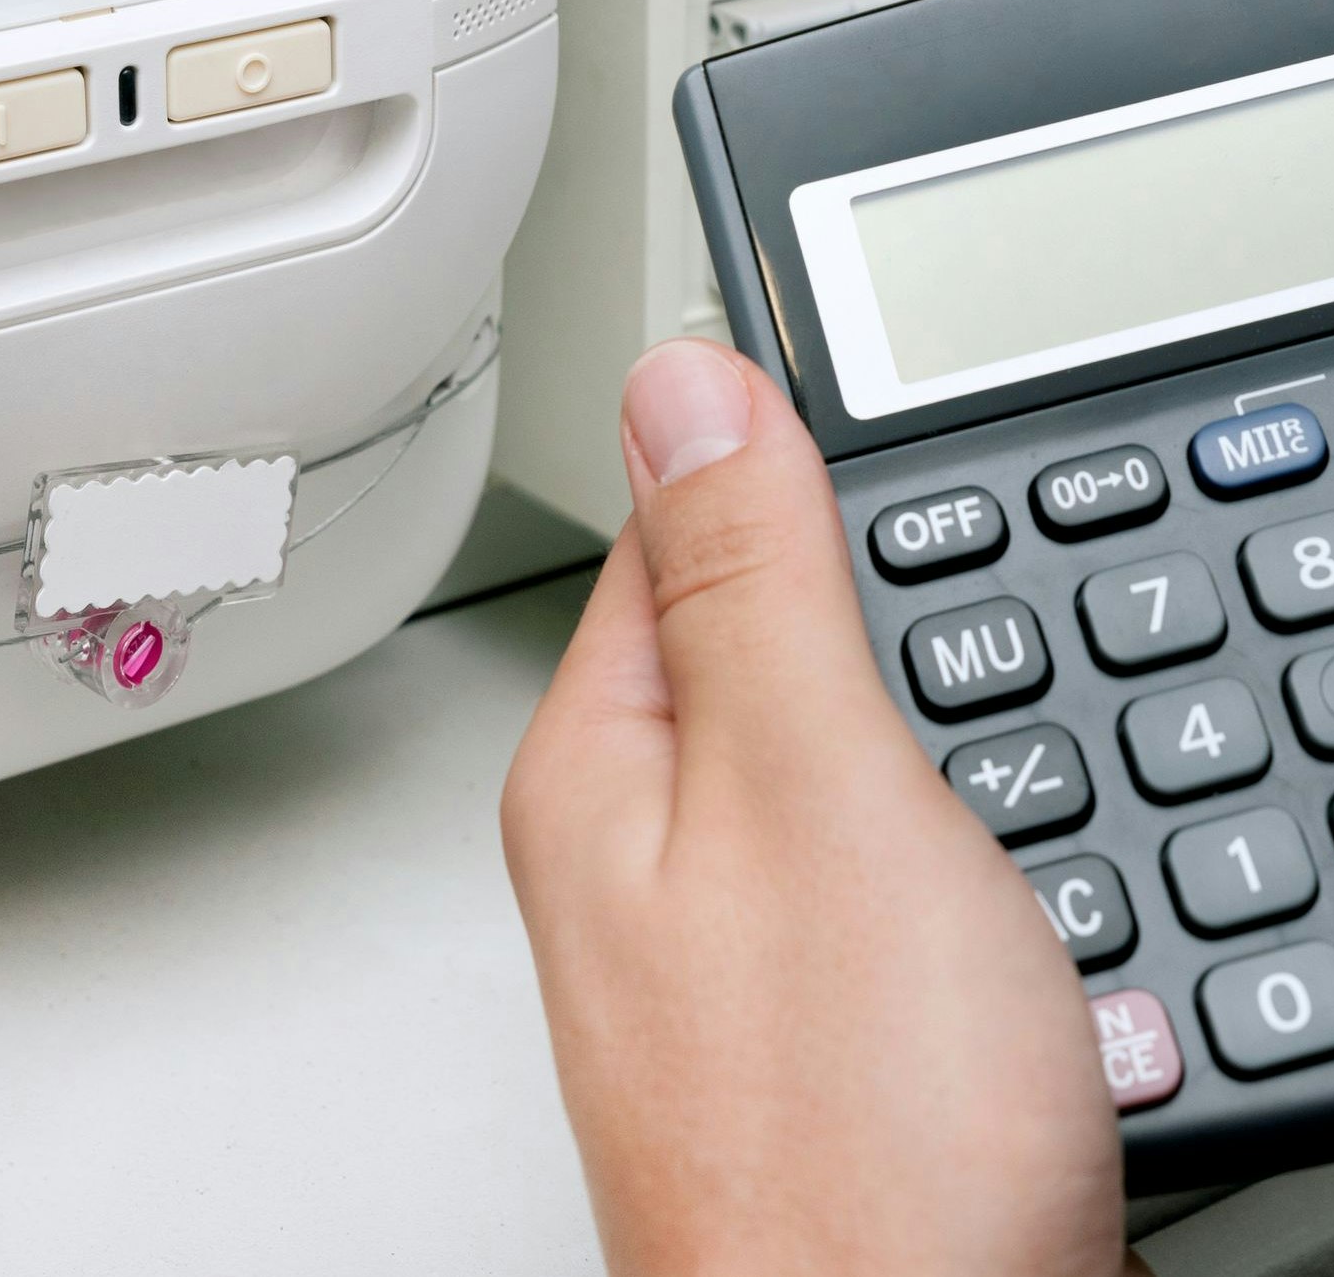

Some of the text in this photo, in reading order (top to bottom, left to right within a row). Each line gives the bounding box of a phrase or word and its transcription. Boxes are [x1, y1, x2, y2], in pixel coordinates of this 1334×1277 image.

[893, 496, 982, 552] OFF
[1129, 576, 1169, 633] 7
[931, 618, 1025, 687] MU
[1179, 703, 1226, 757] 4
[1227, 836, 1261, 892] 1
[1257, 972, 1312, 1032] 0
